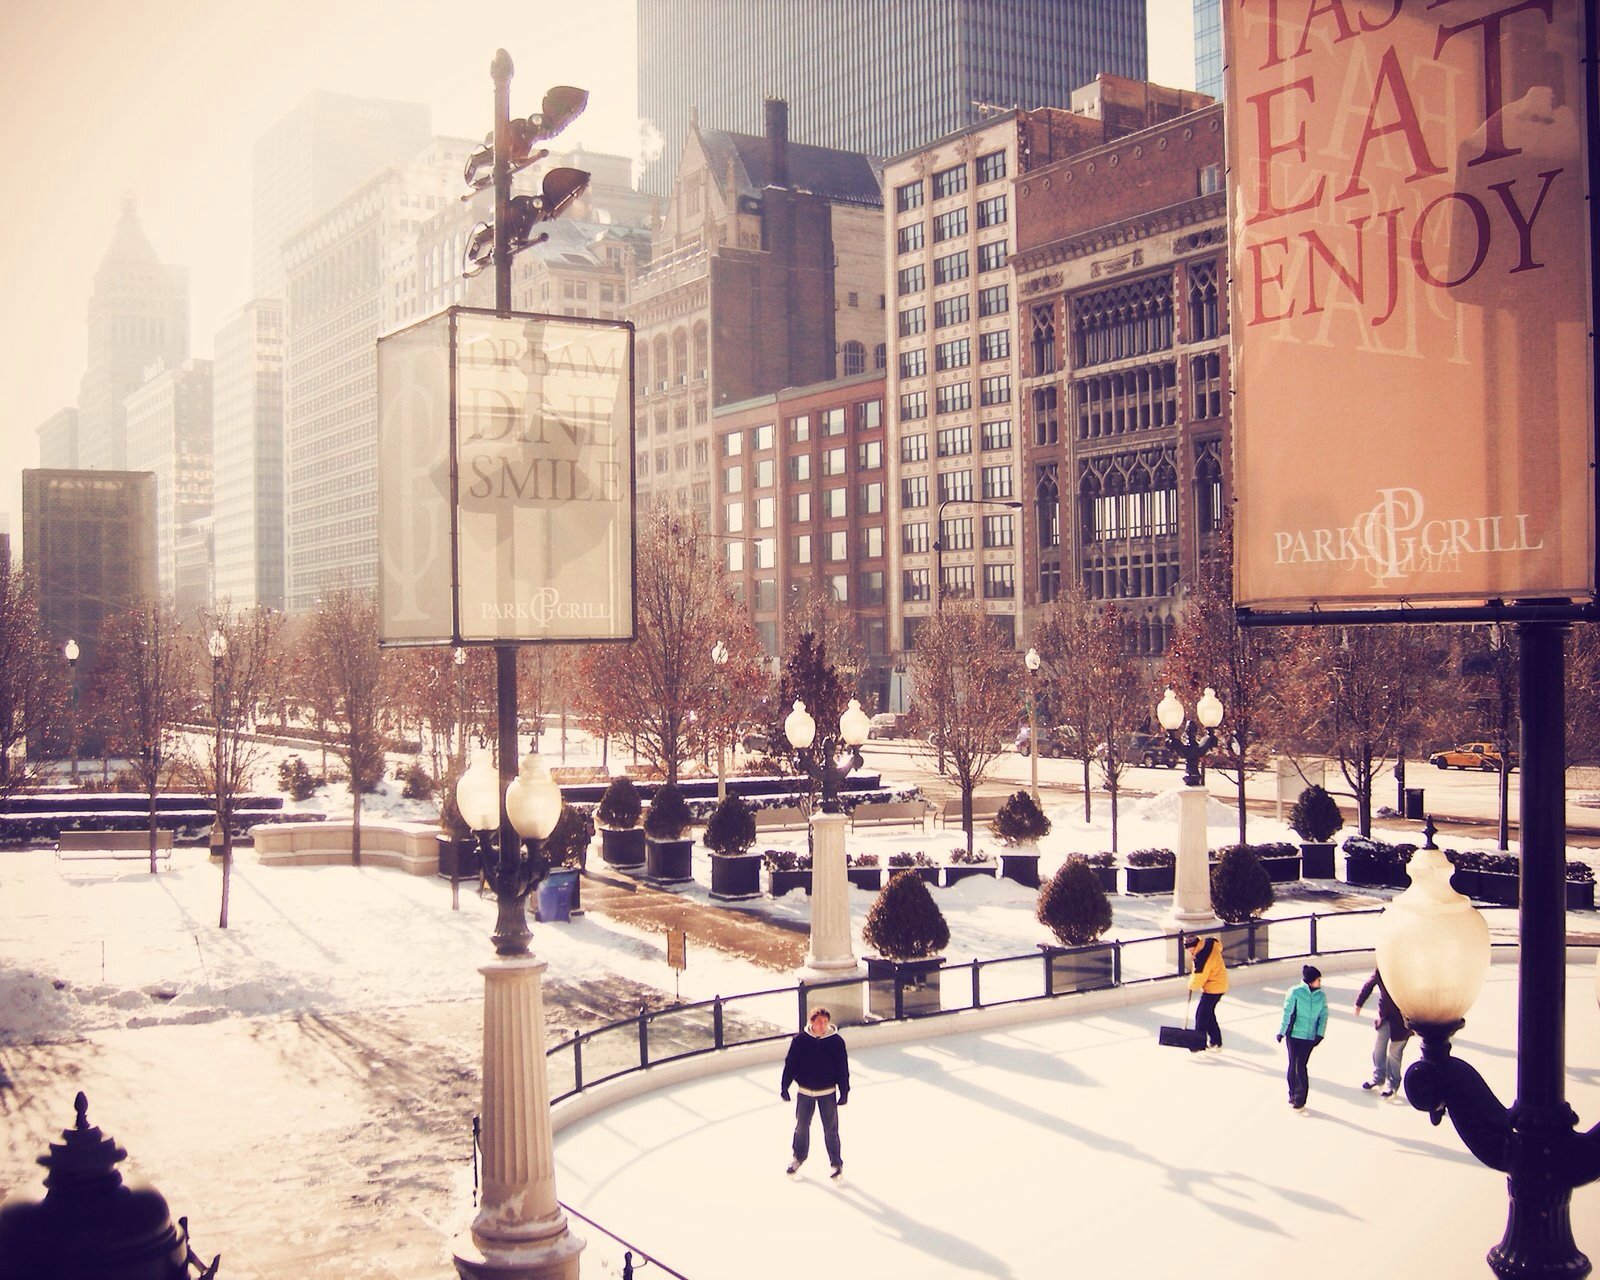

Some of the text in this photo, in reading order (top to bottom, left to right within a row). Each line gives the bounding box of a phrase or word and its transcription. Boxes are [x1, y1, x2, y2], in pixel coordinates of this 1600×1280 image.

[1246, 0, 1553, 226] EAT
[1246, 168, 1564, 327] ENJOY
[467, 338, 621, 381] DREAM
[467, 388, 620, 447] DINE
[470, 455, 625, 502] SMILE
[1273, 526, 1365, 565] PARK
[1421, 514, 1544, 556] GRILL
[480, 602, 529, 619] PARK
[556, 602, 609, 619] GRILL
